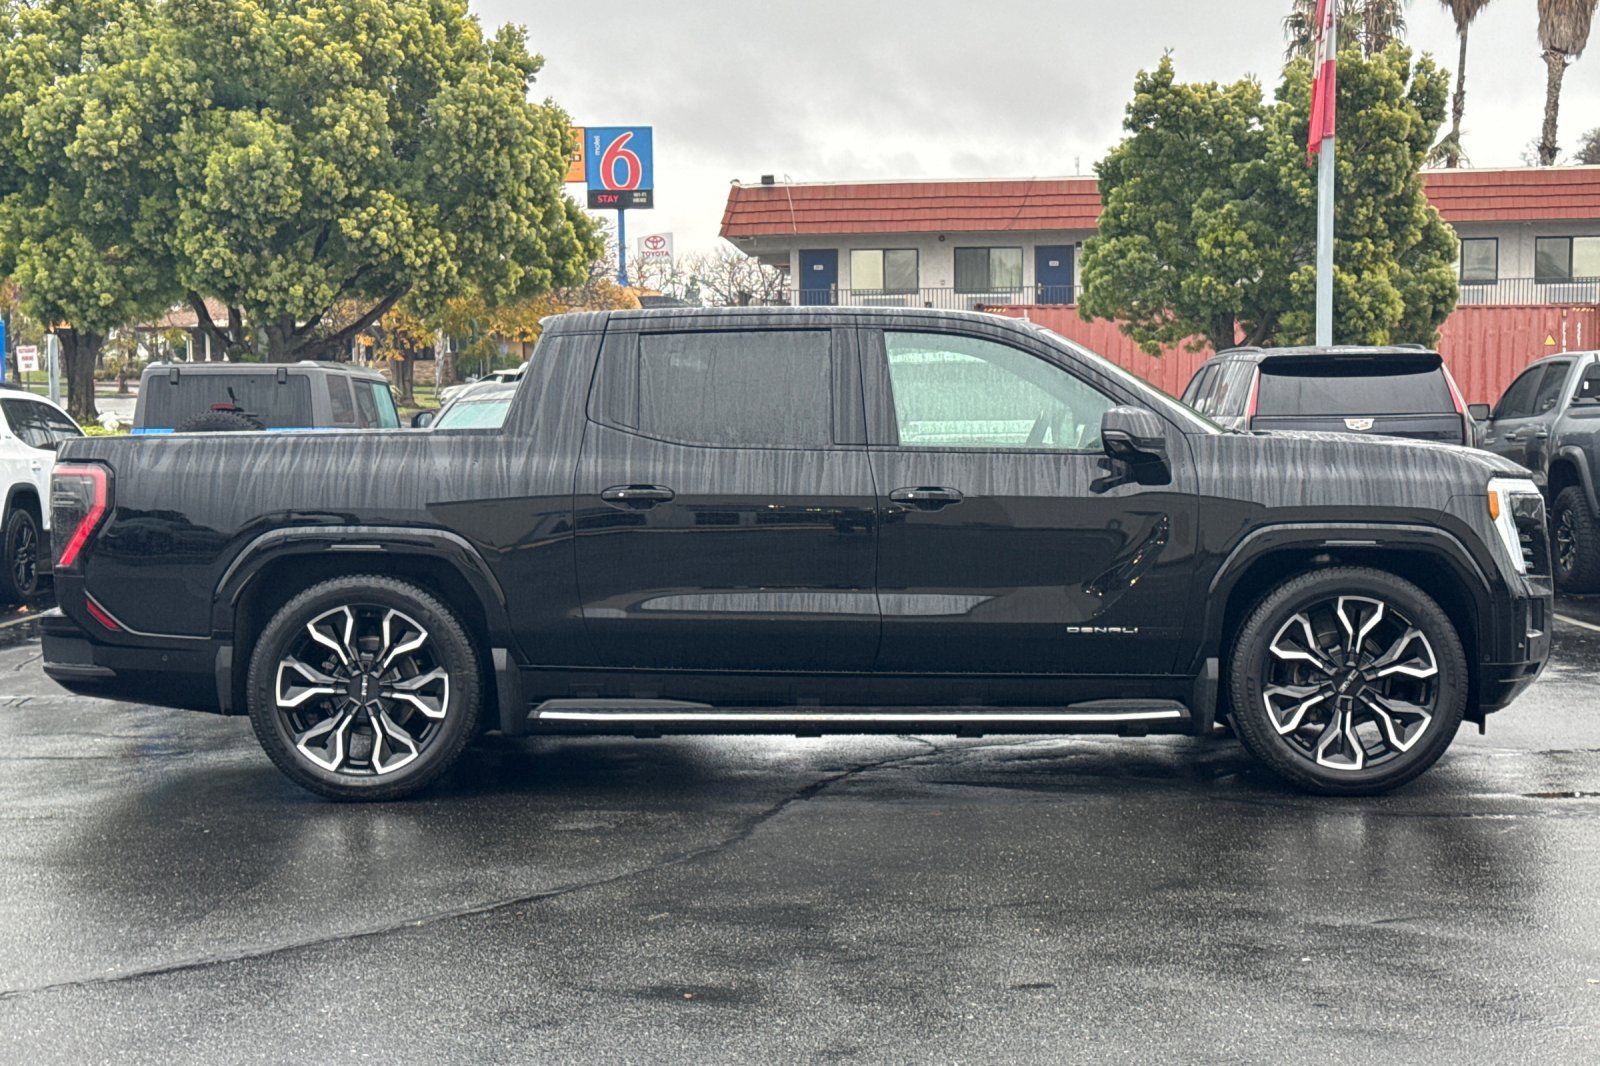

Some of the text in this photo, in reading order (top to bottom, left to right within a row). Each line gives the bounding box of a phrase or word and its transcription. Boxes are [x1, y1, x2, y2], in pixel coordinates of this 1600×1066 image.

[593, 135, 601, 156] motel
[600, 131, 642, 190] 6
[597, 194, 619, 203] STAY
